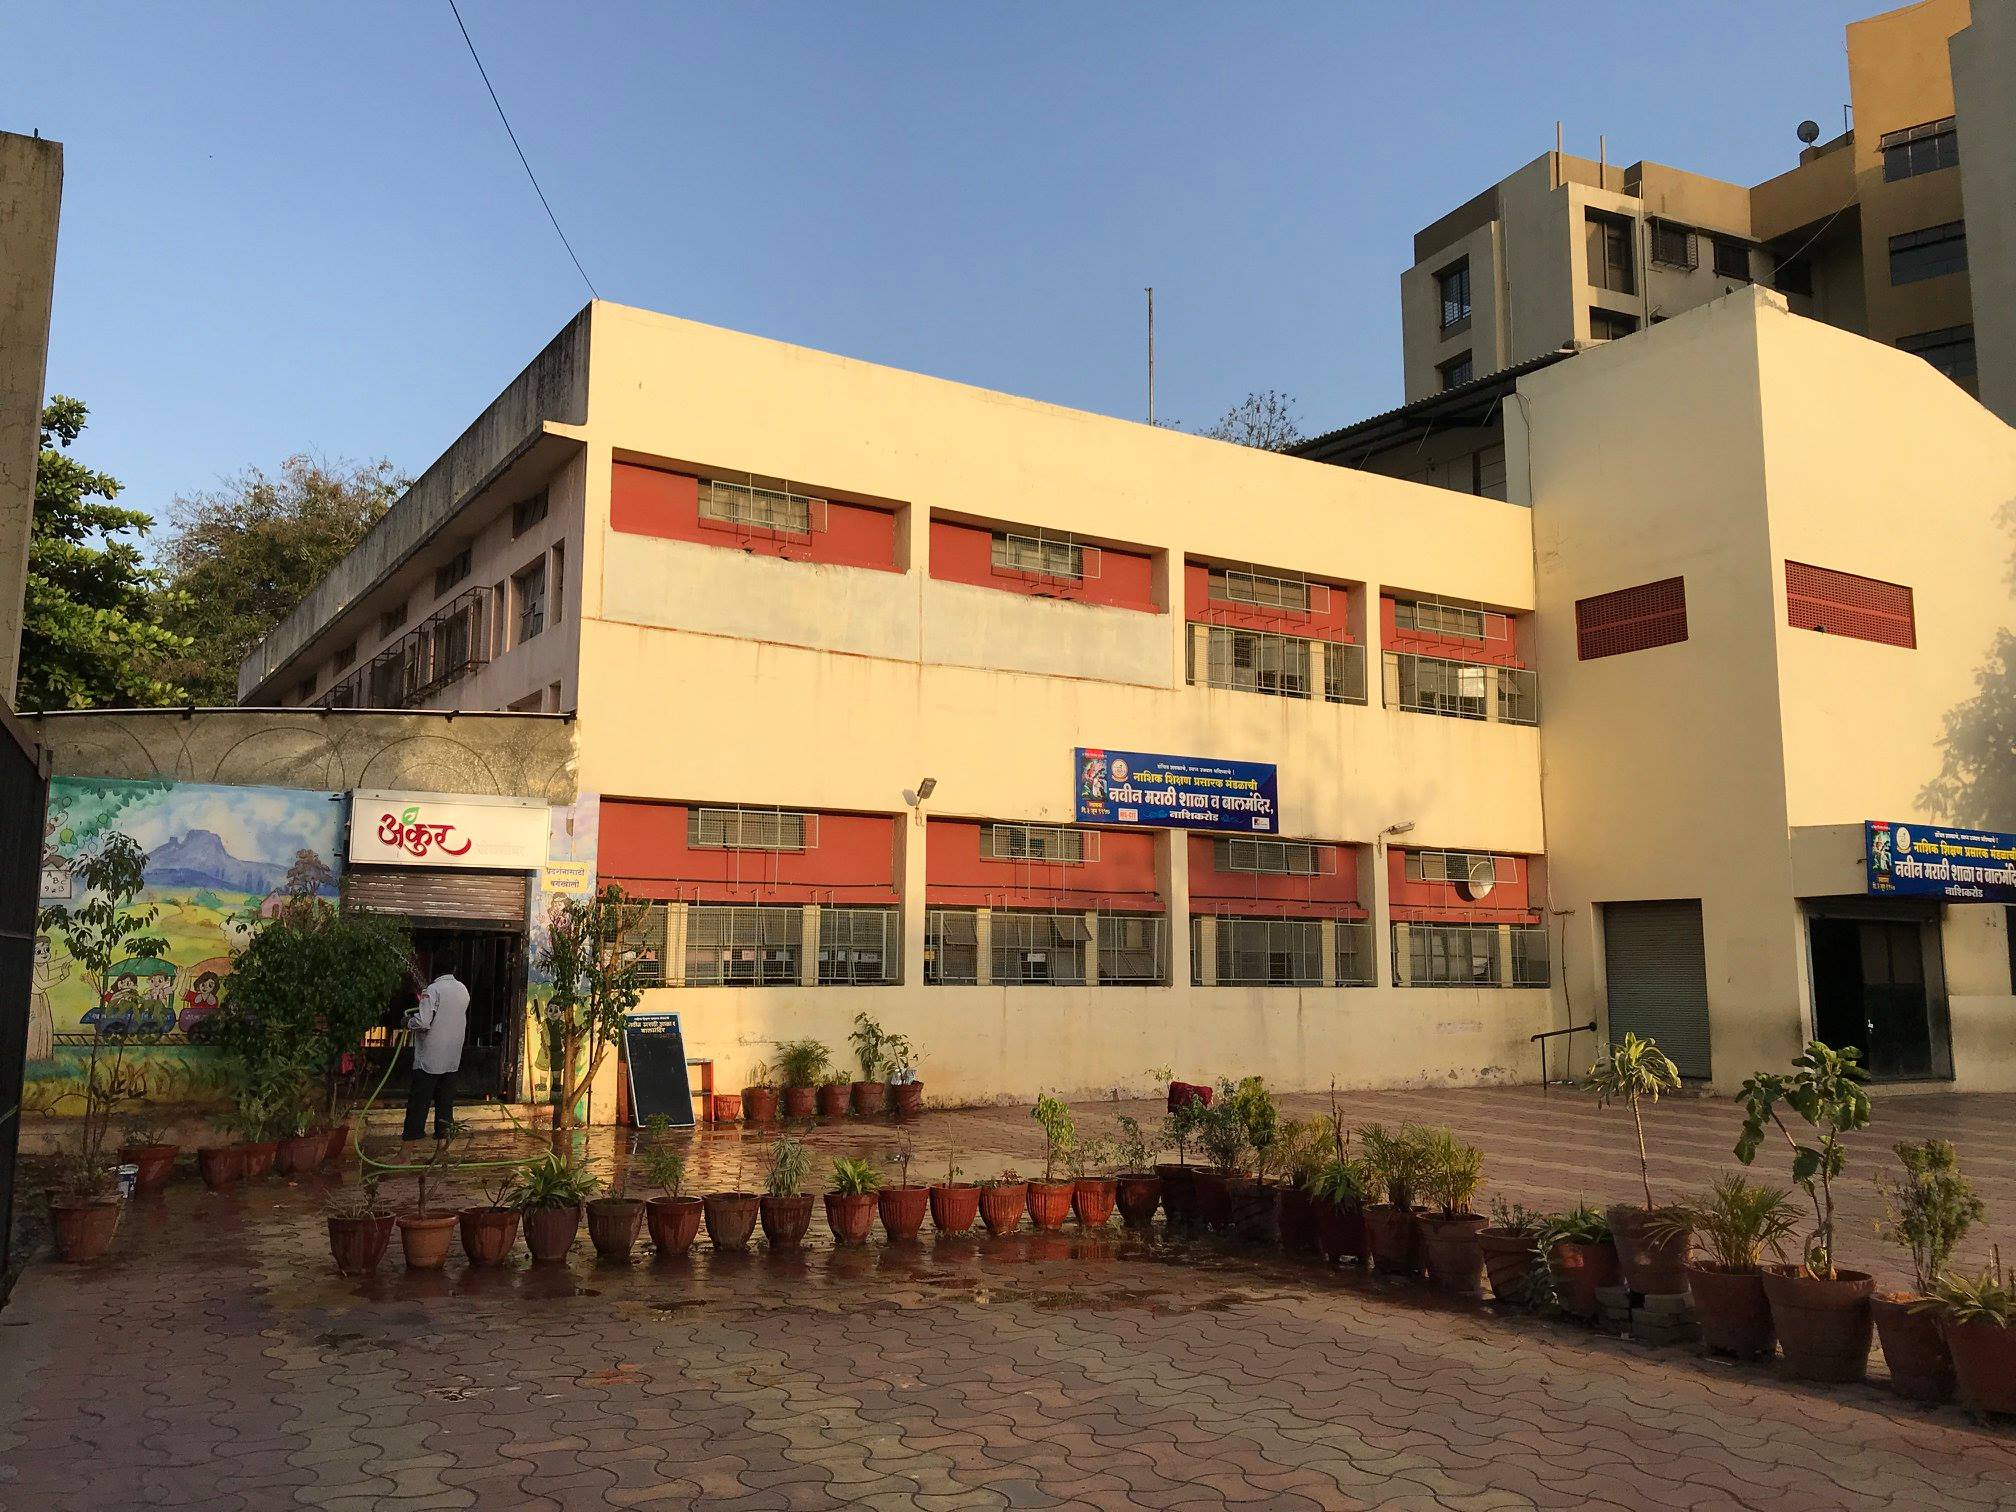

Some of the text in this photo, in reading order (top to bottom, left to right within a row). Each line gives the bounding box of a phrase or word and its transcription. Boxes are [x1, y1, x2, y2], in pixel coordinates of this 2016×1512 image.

[1133, 770, 1258, 791] नाशिक शिक्षण प्रसारक मंडळाची
[1108, 783, 1274, 815] नवीन मराठी शाळा व बालमंदिर,
[1169, 809, 1219, 822] नाशिकरोड
[377, 806, 472, 858] अंकुर
[1912, 838, 1938, 854] नाशिक
[1940, 840, 1963, 857] शिक्षण
[1964, 846, 1989, 859] प्रसारक
[1895, 854, 1923, 879] नवीन
[1923, 857, 1950, 880] मराठी
[1950, 864, 1975, 882] शाळा
[1944, 884, 1984, 898] नाशिकरोड
